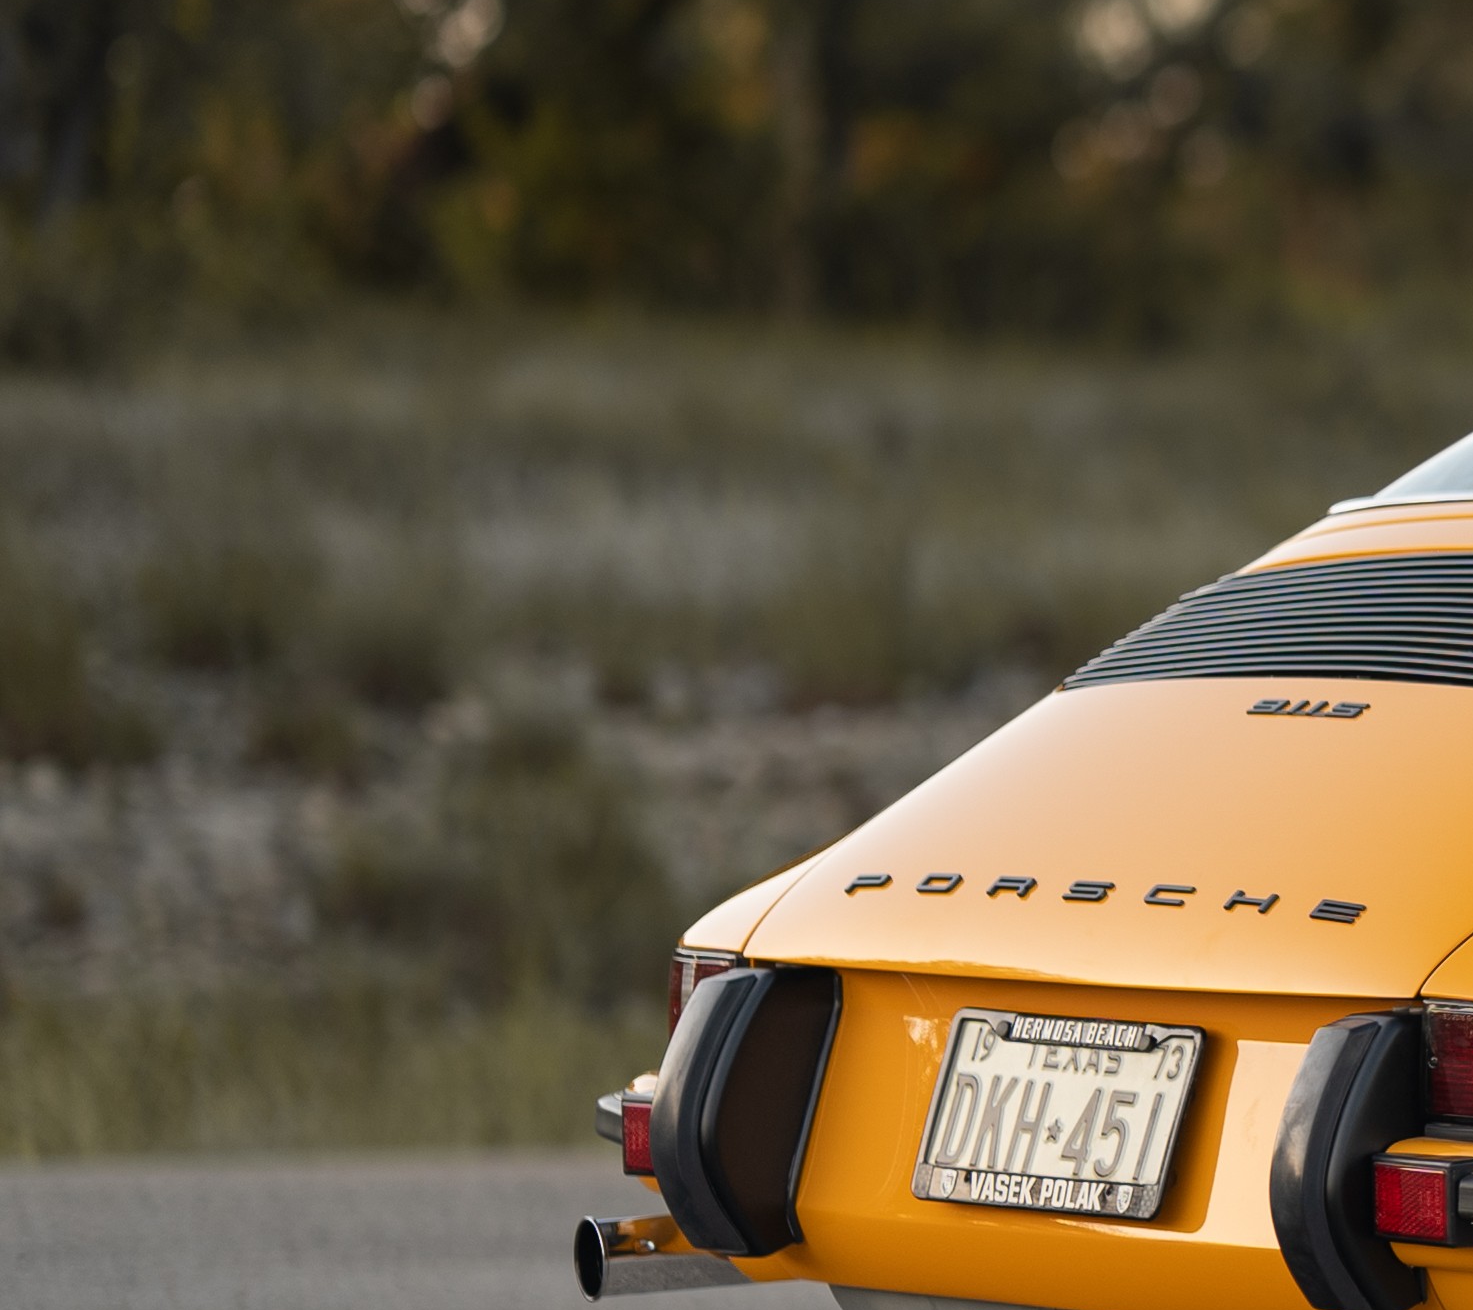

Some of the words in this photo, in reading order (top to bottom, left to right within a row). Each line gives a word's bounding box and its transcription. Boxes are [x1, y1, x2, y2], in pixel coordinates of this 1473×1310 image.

[1246, 699, 1371, 718] 911S
[844, 872, 1368, 925] PORSCHE
[1012, 1015, 1081, 1045] HERMOSA
[1086, 1023, 1139, 1048] BEACH
[971, 1026, 996, 1063] 19
[1152, 1044, 1185, 1082] 73
[968, 1170, 1035, 1206] VASEK
[1038, 1178, 1106, 1213] POLAK
